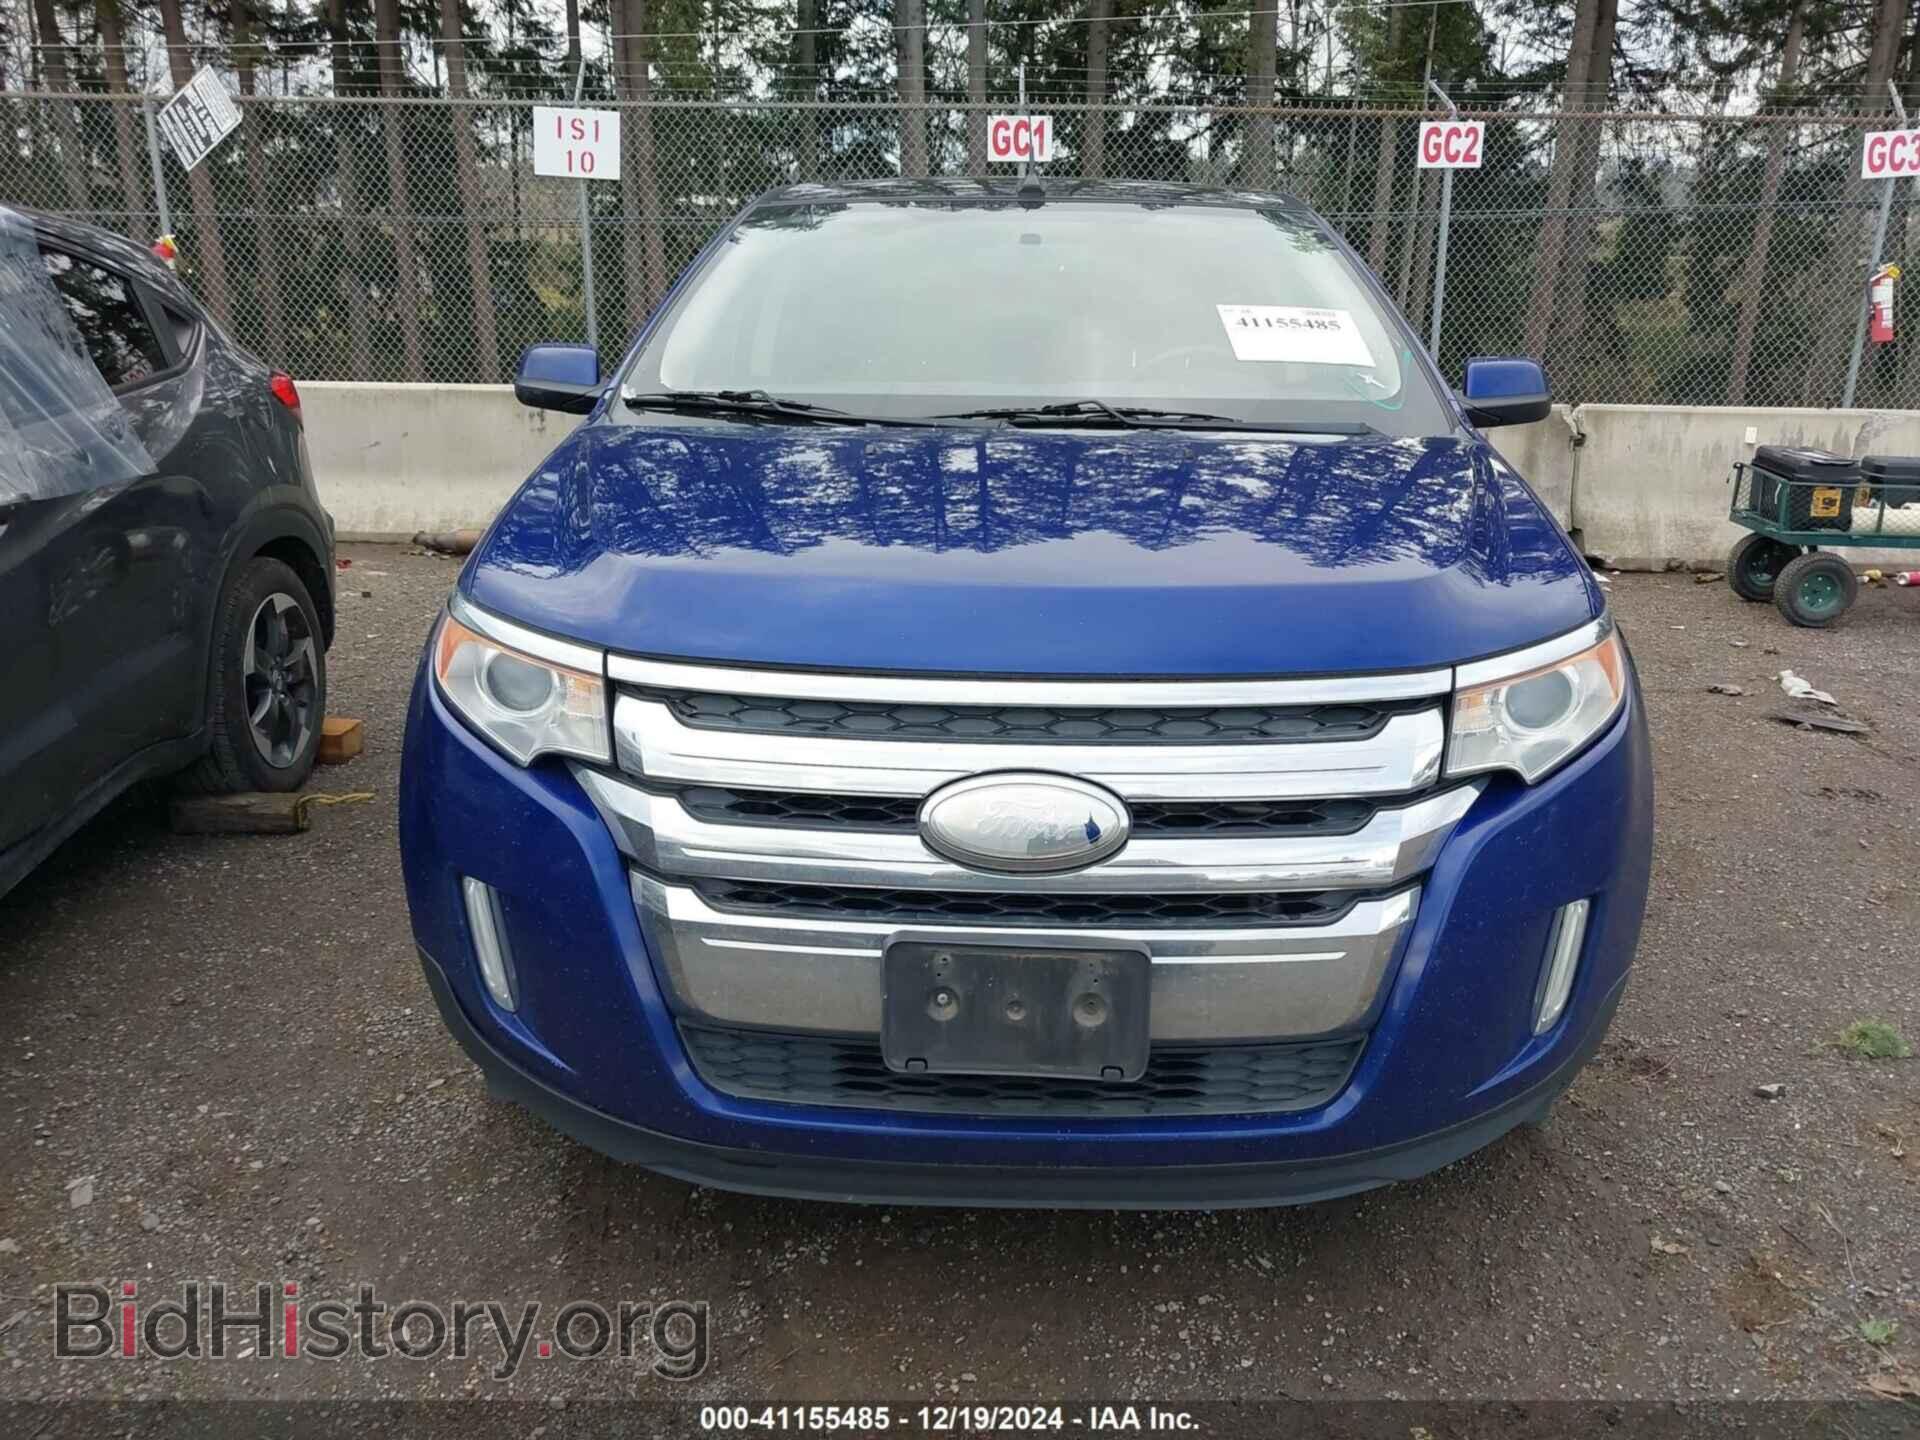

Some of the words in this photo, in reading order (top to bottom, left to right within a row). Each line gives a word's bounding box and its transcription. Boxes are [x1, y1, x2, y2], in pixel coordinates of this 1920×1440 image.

[992, 119, 1045, 156] GC1
[1423, 126, 1480, 163] GC2
[1868, 134, 1920, 172] GC3
[567, 149, 595, 173] 10
[1236, 317, 1342, 331] 41155485
